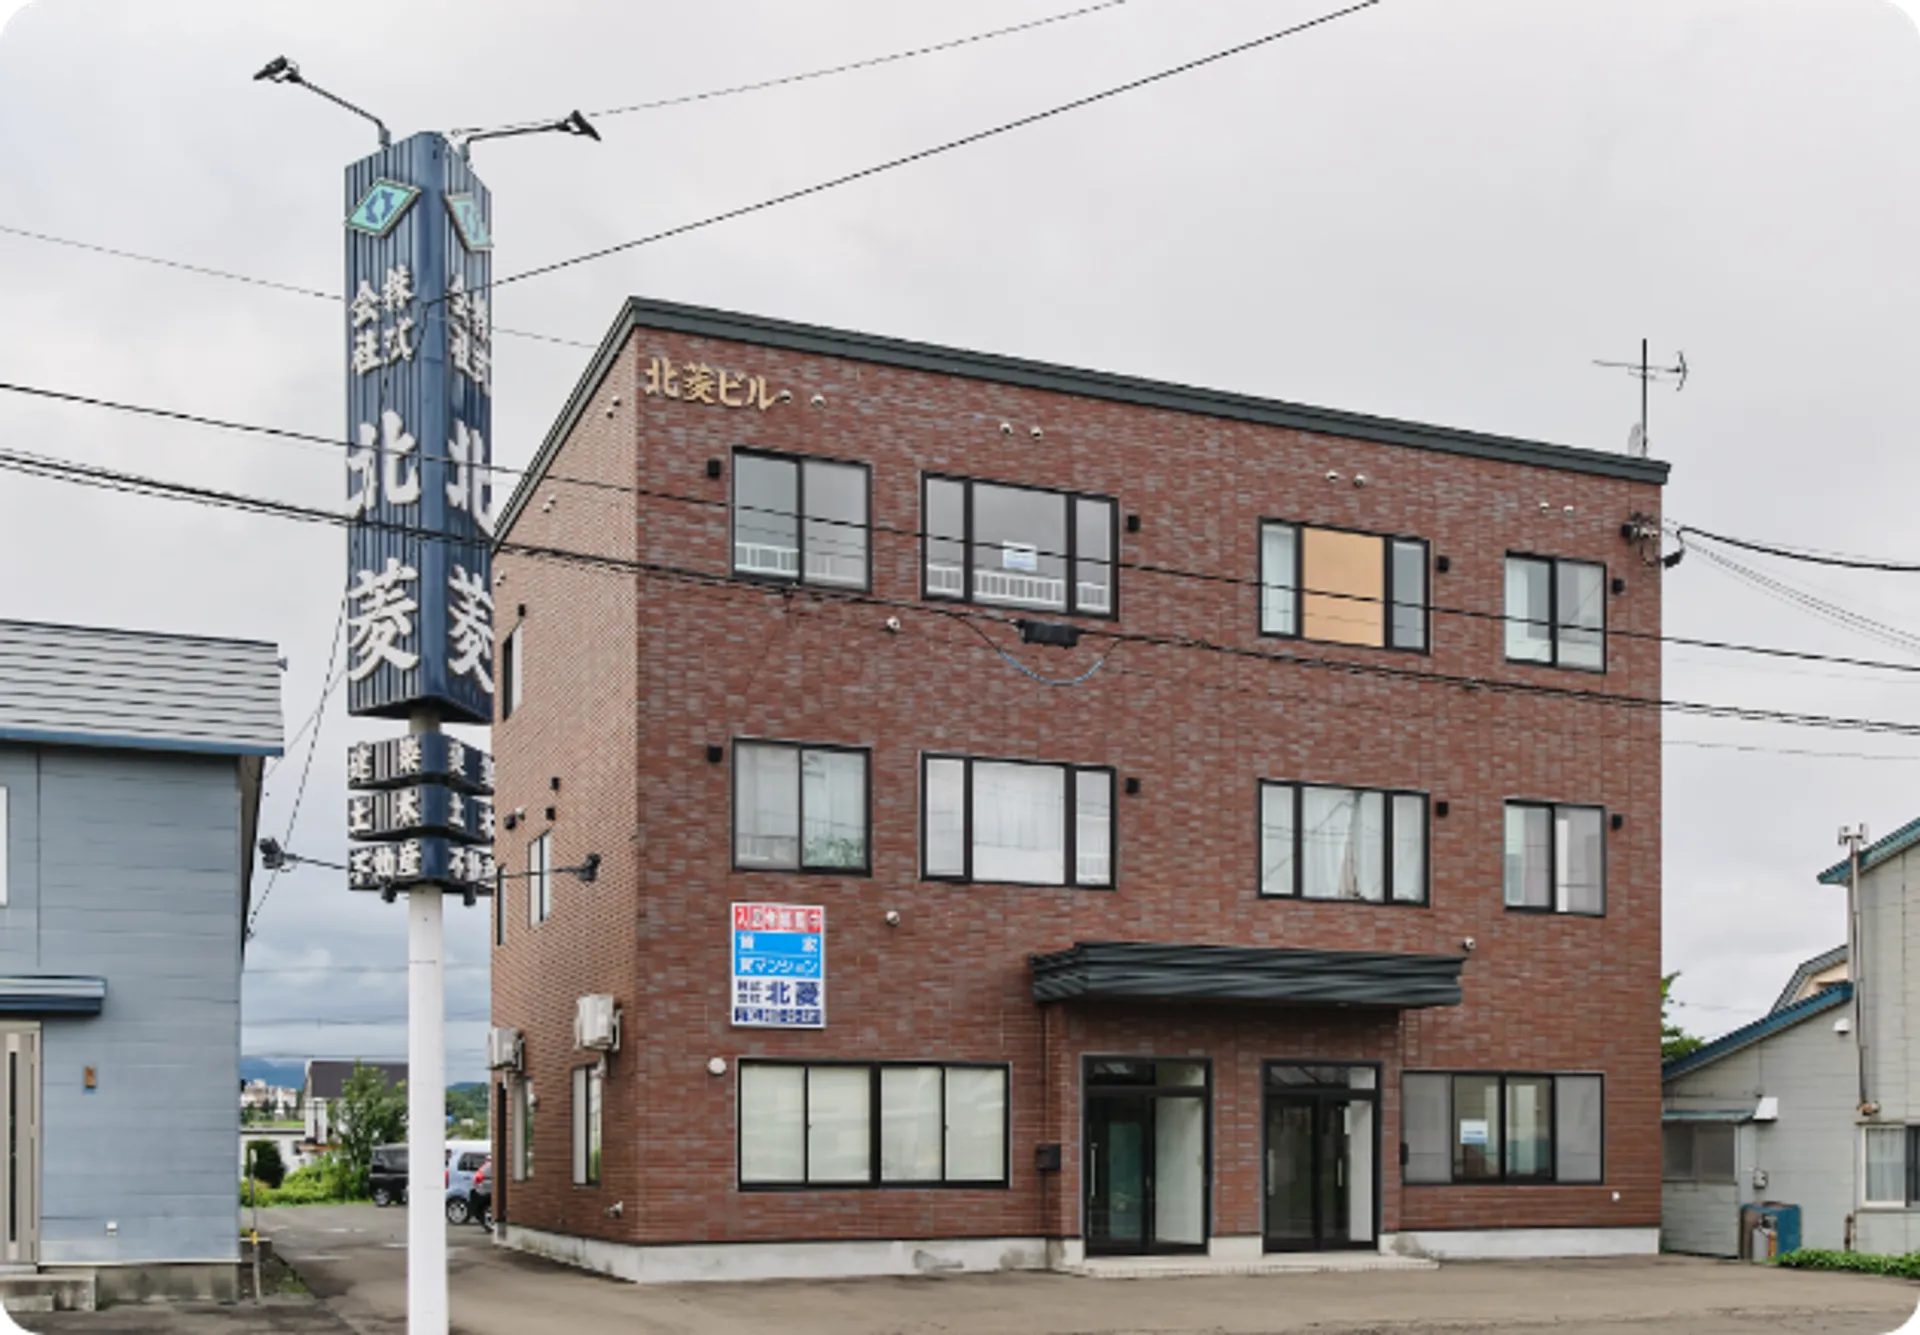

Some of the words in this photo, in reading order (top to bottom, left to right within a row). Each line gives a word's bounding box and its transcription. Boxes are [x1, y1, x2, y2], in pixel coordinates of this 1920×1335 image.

[643, 357, 777, 411] 北菱ビル
[346, 409, 420, 683] 北菱
[446, 419, 494, 693] 北菱
